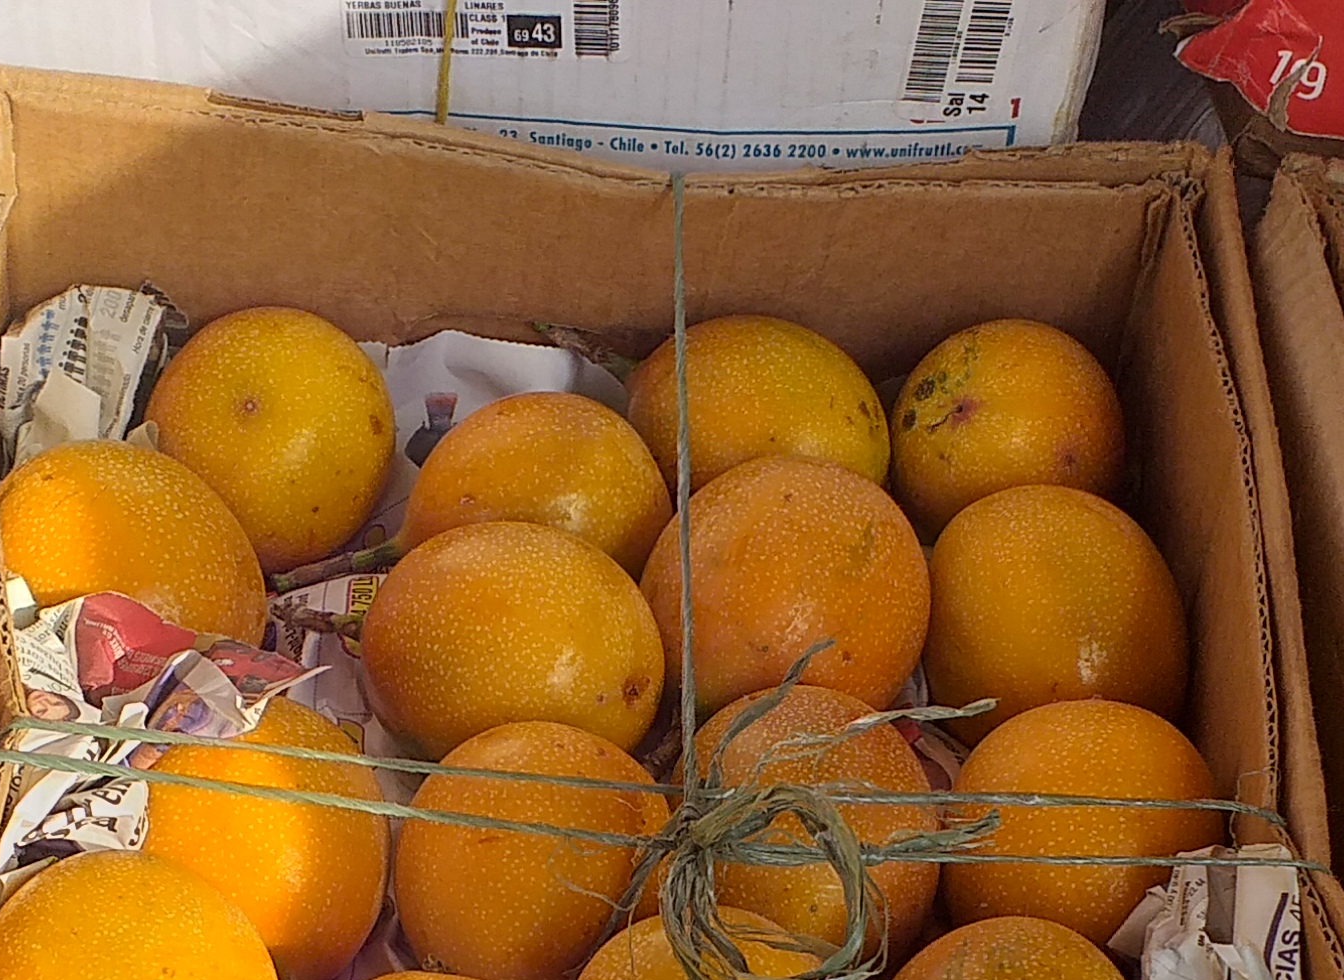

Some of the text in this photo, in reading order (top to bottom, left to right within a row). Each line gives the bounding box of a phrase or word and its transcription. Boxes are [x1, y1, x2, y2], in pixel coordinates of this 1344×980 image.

[346, 0, 422, 9] YERBAS BUENAS
[468, 14, 498, 22] CLASS
[531, 22, 556, 43] 43
[943, 93, 966, 117] Sal
[967, 93, 989, 115] 14
[529, 131, 593, 151] Santiago
[610, 135, 645, 153] Chile
[664, 140, 690, 156] Tel.
[695, 143, 737, 160] 56(2)
[743, 143, 782, 158] 2636
[787, 144, 827, 159] 2200
